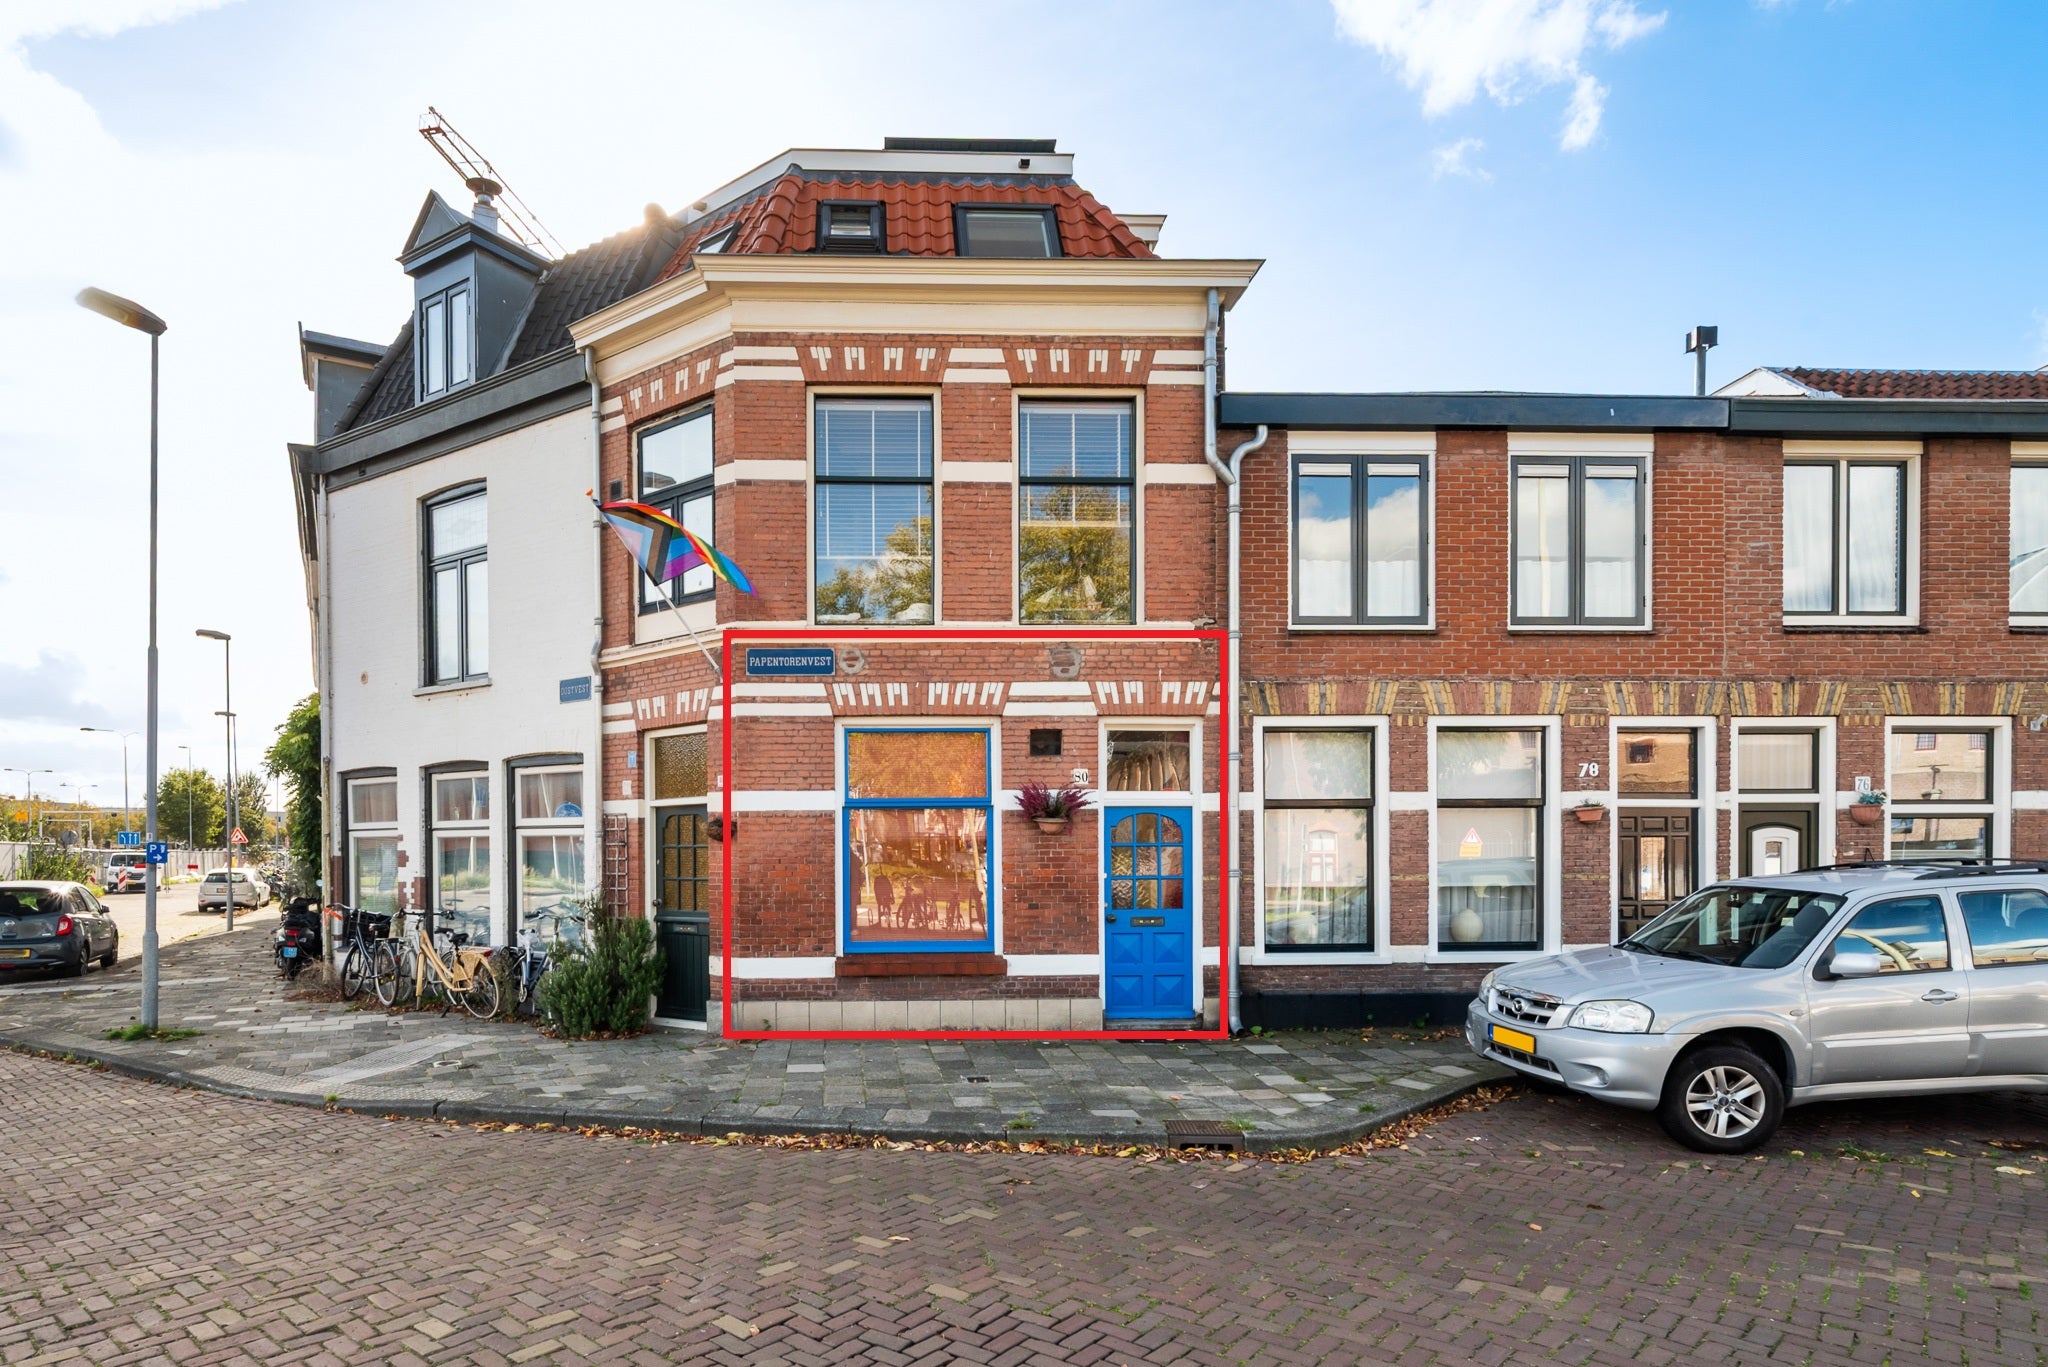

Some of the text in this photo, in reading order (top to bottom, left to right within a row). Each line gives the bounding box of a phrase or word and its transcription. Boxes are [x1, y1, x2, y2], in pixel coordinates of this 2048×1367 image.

[749, 656, 832, 667] PAPENTORENVEST
[561, 684, 589, 695] OOSTVEST
[1579, 762, 1599, 777] 78
[1075, 771, 1088, 782] 80
[1857, 778, 1870, 790] 76
